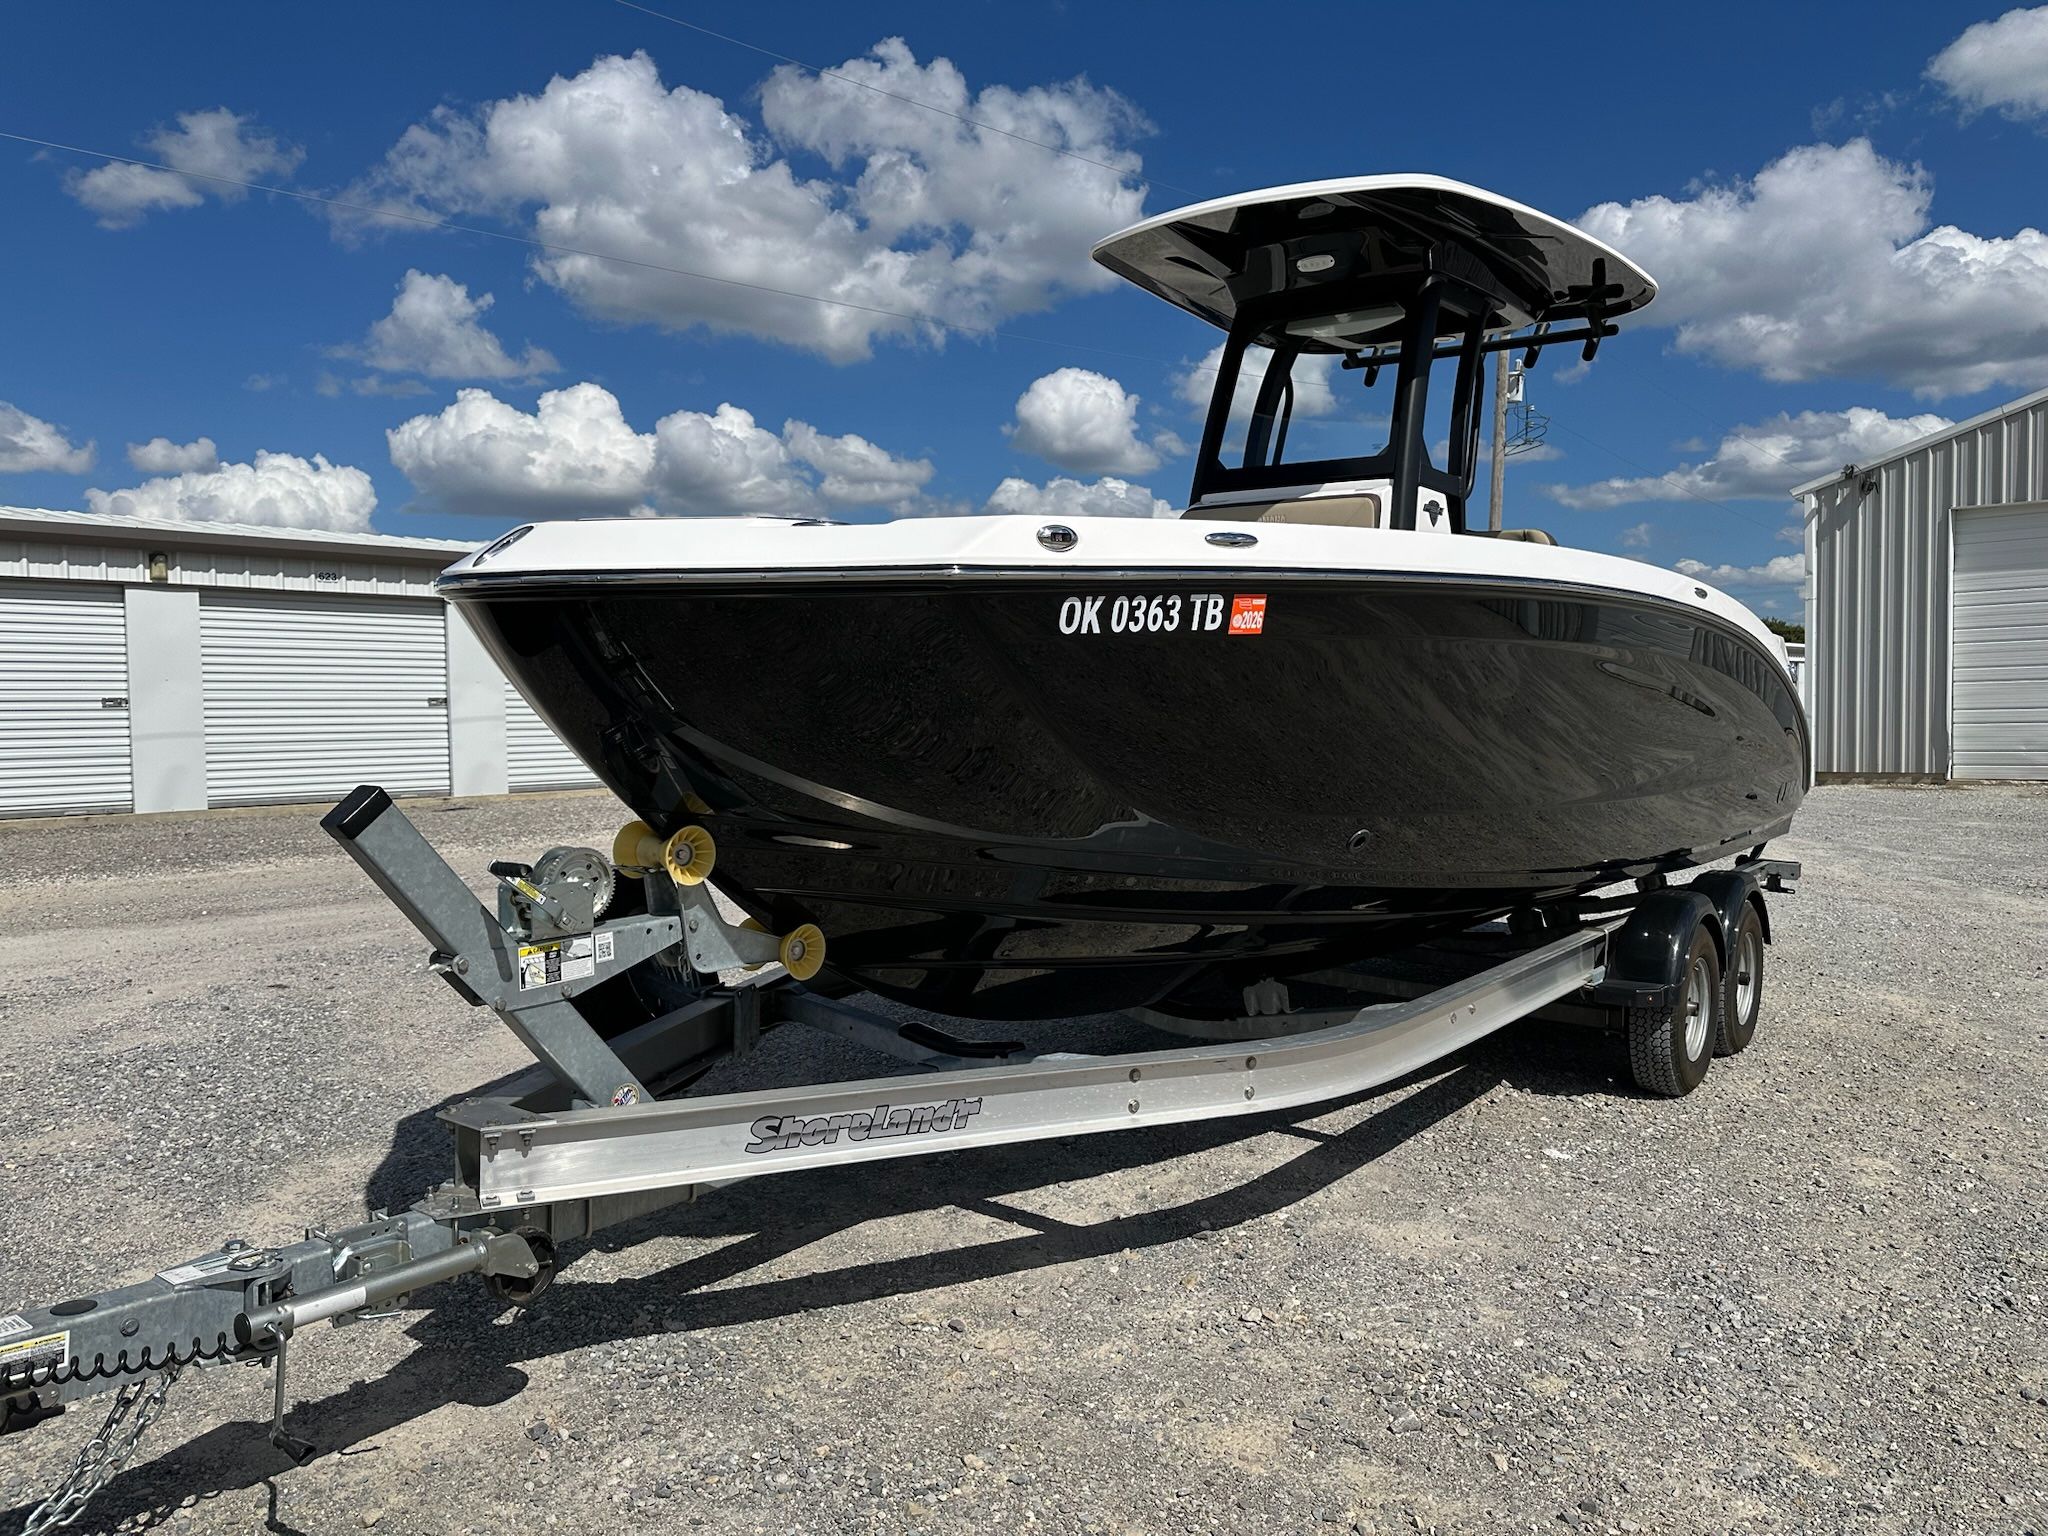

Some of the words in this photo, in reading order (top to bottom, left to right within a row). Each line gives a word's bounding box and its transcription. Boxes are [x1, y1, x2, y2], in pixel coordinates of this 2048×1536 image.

[318, 572, 337, 581] 623
[1058, 596, 1106, 635] OK
[1111, 594, 1182, 633] 0363
[1190, 593, 1225, 631] TB
[1240, 611, 1264, 629] 2026
